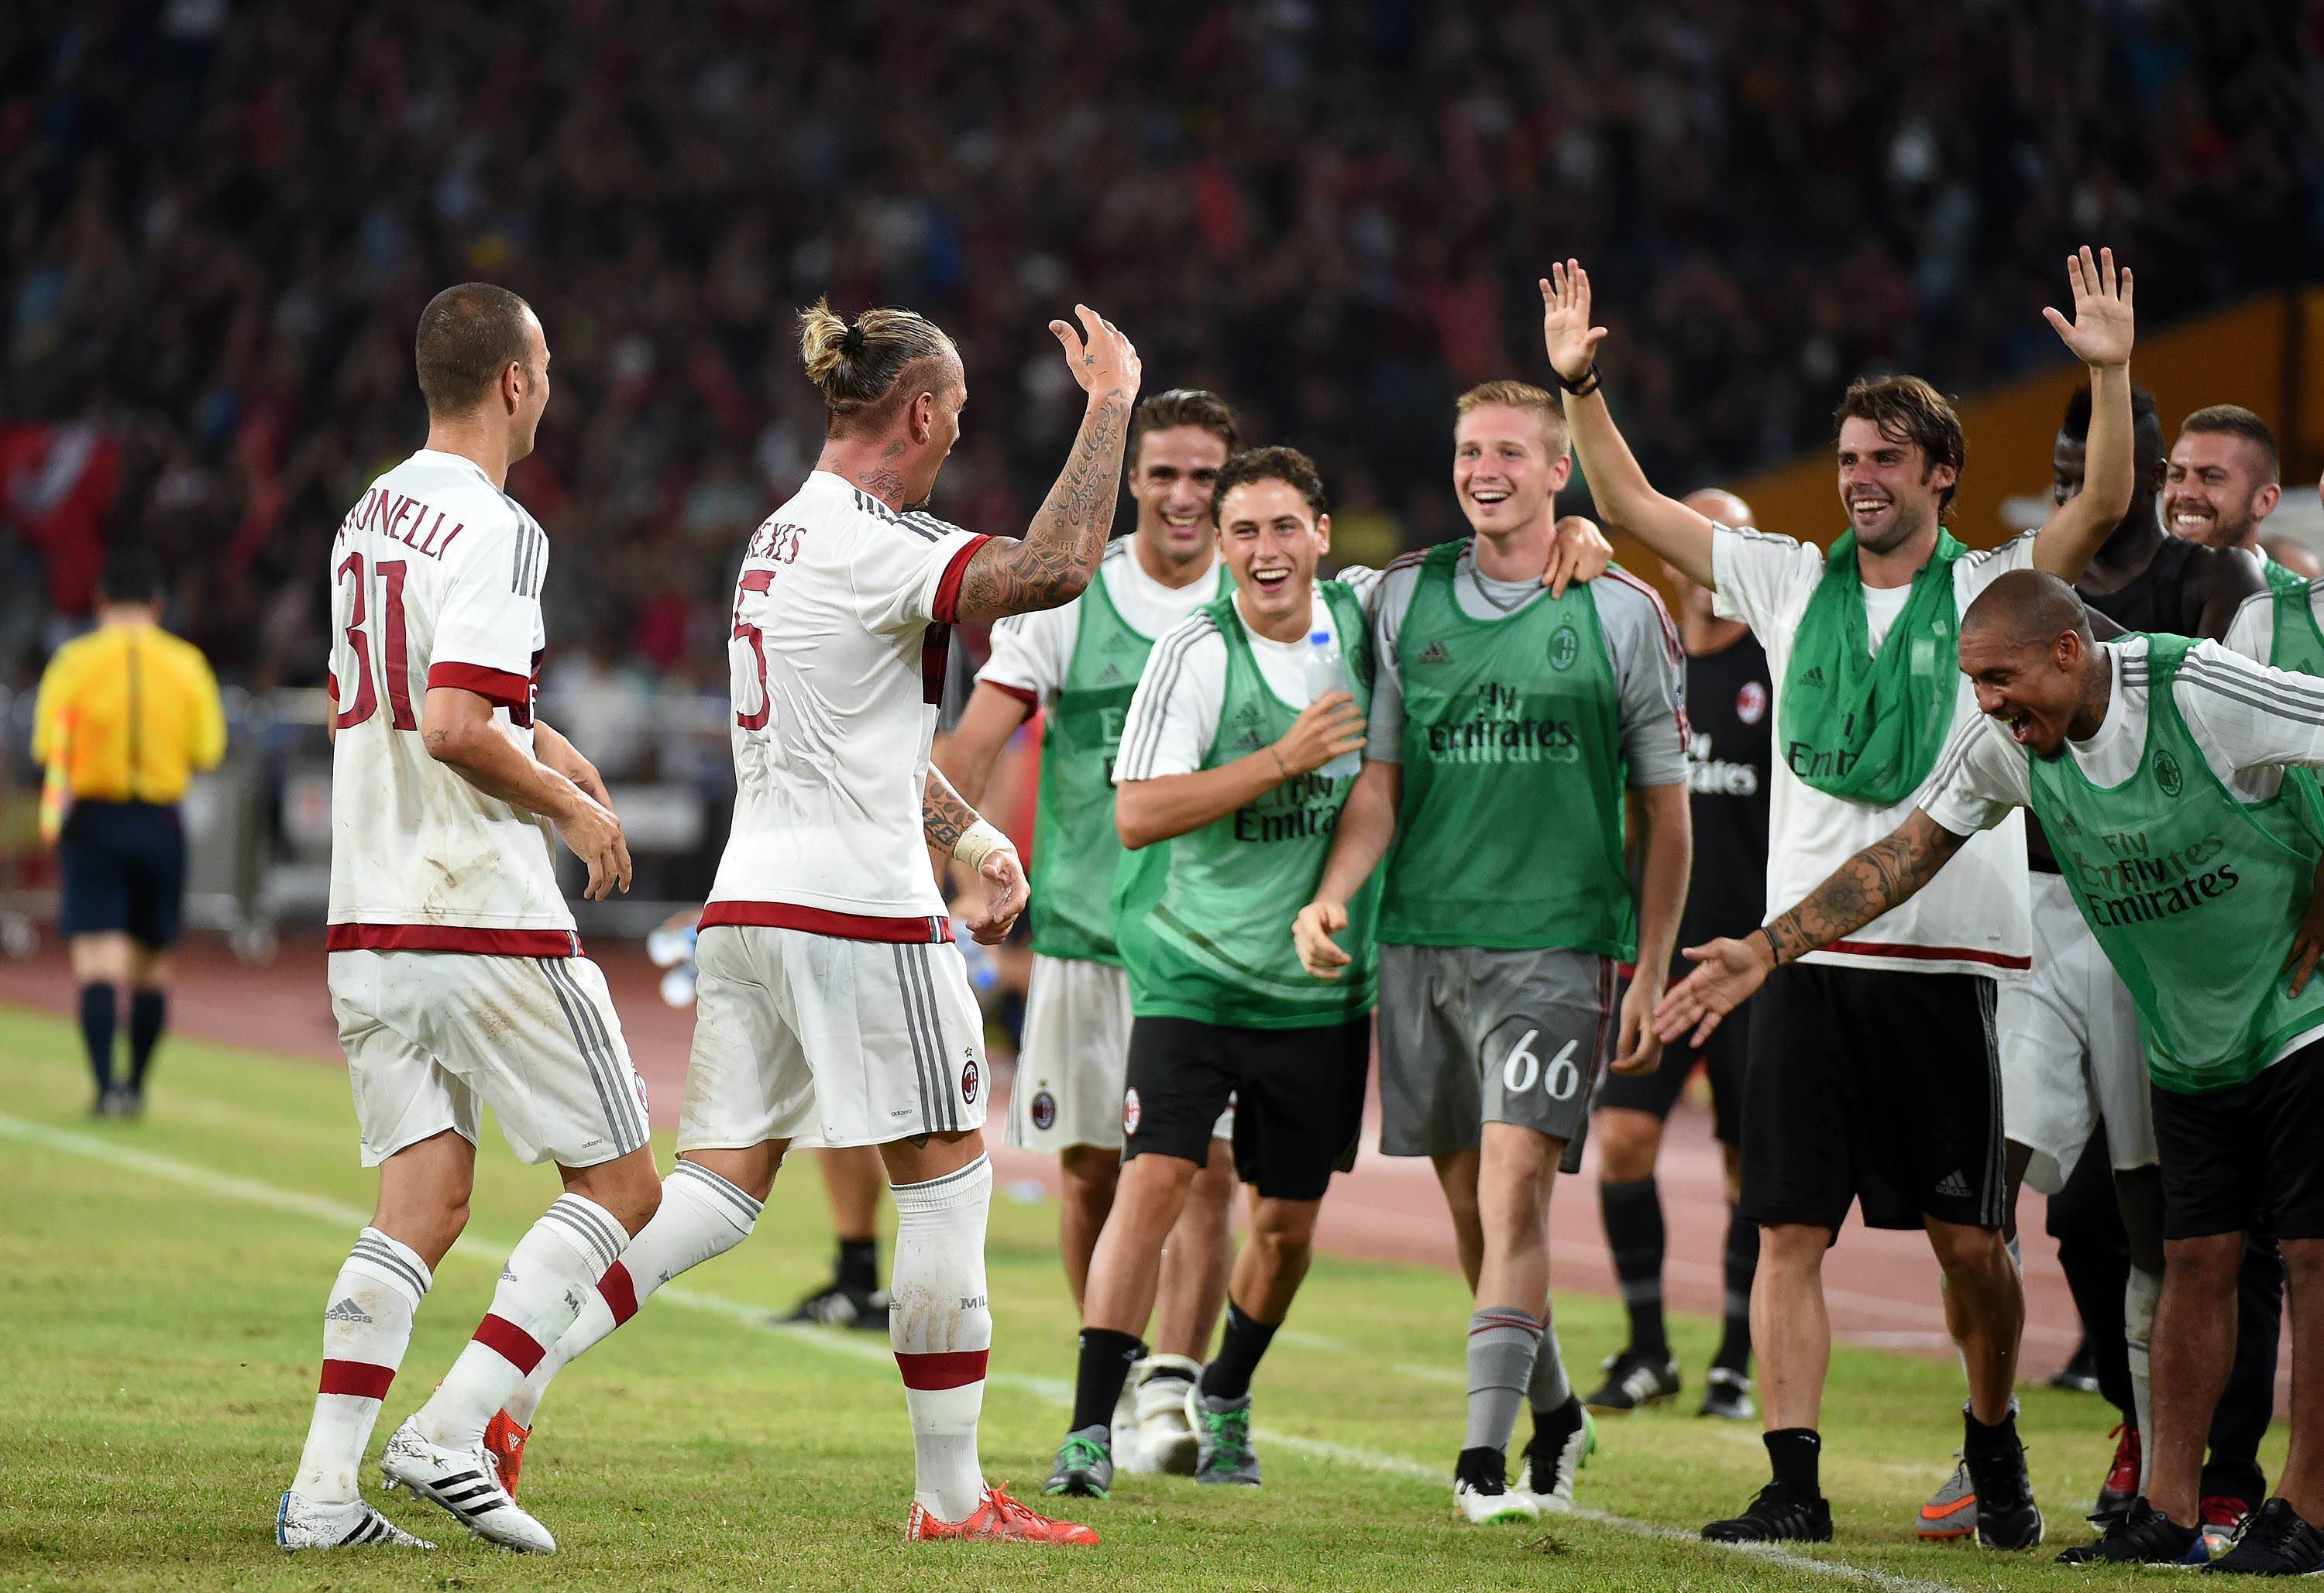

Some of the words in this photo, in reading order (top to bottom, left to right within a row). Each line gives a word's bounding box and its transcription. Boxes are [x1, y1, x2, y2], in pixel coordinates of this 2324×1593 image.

[339, 487, 464, 561] ONELLI
[338, 551, 418, 731] 31
[734, 569, 777, 731] 5
[2085, 863, 2239, 927] Emirates
[1503, 1028, 1580, 1100] 66
[325, 1312, 373, 1324] adidas
